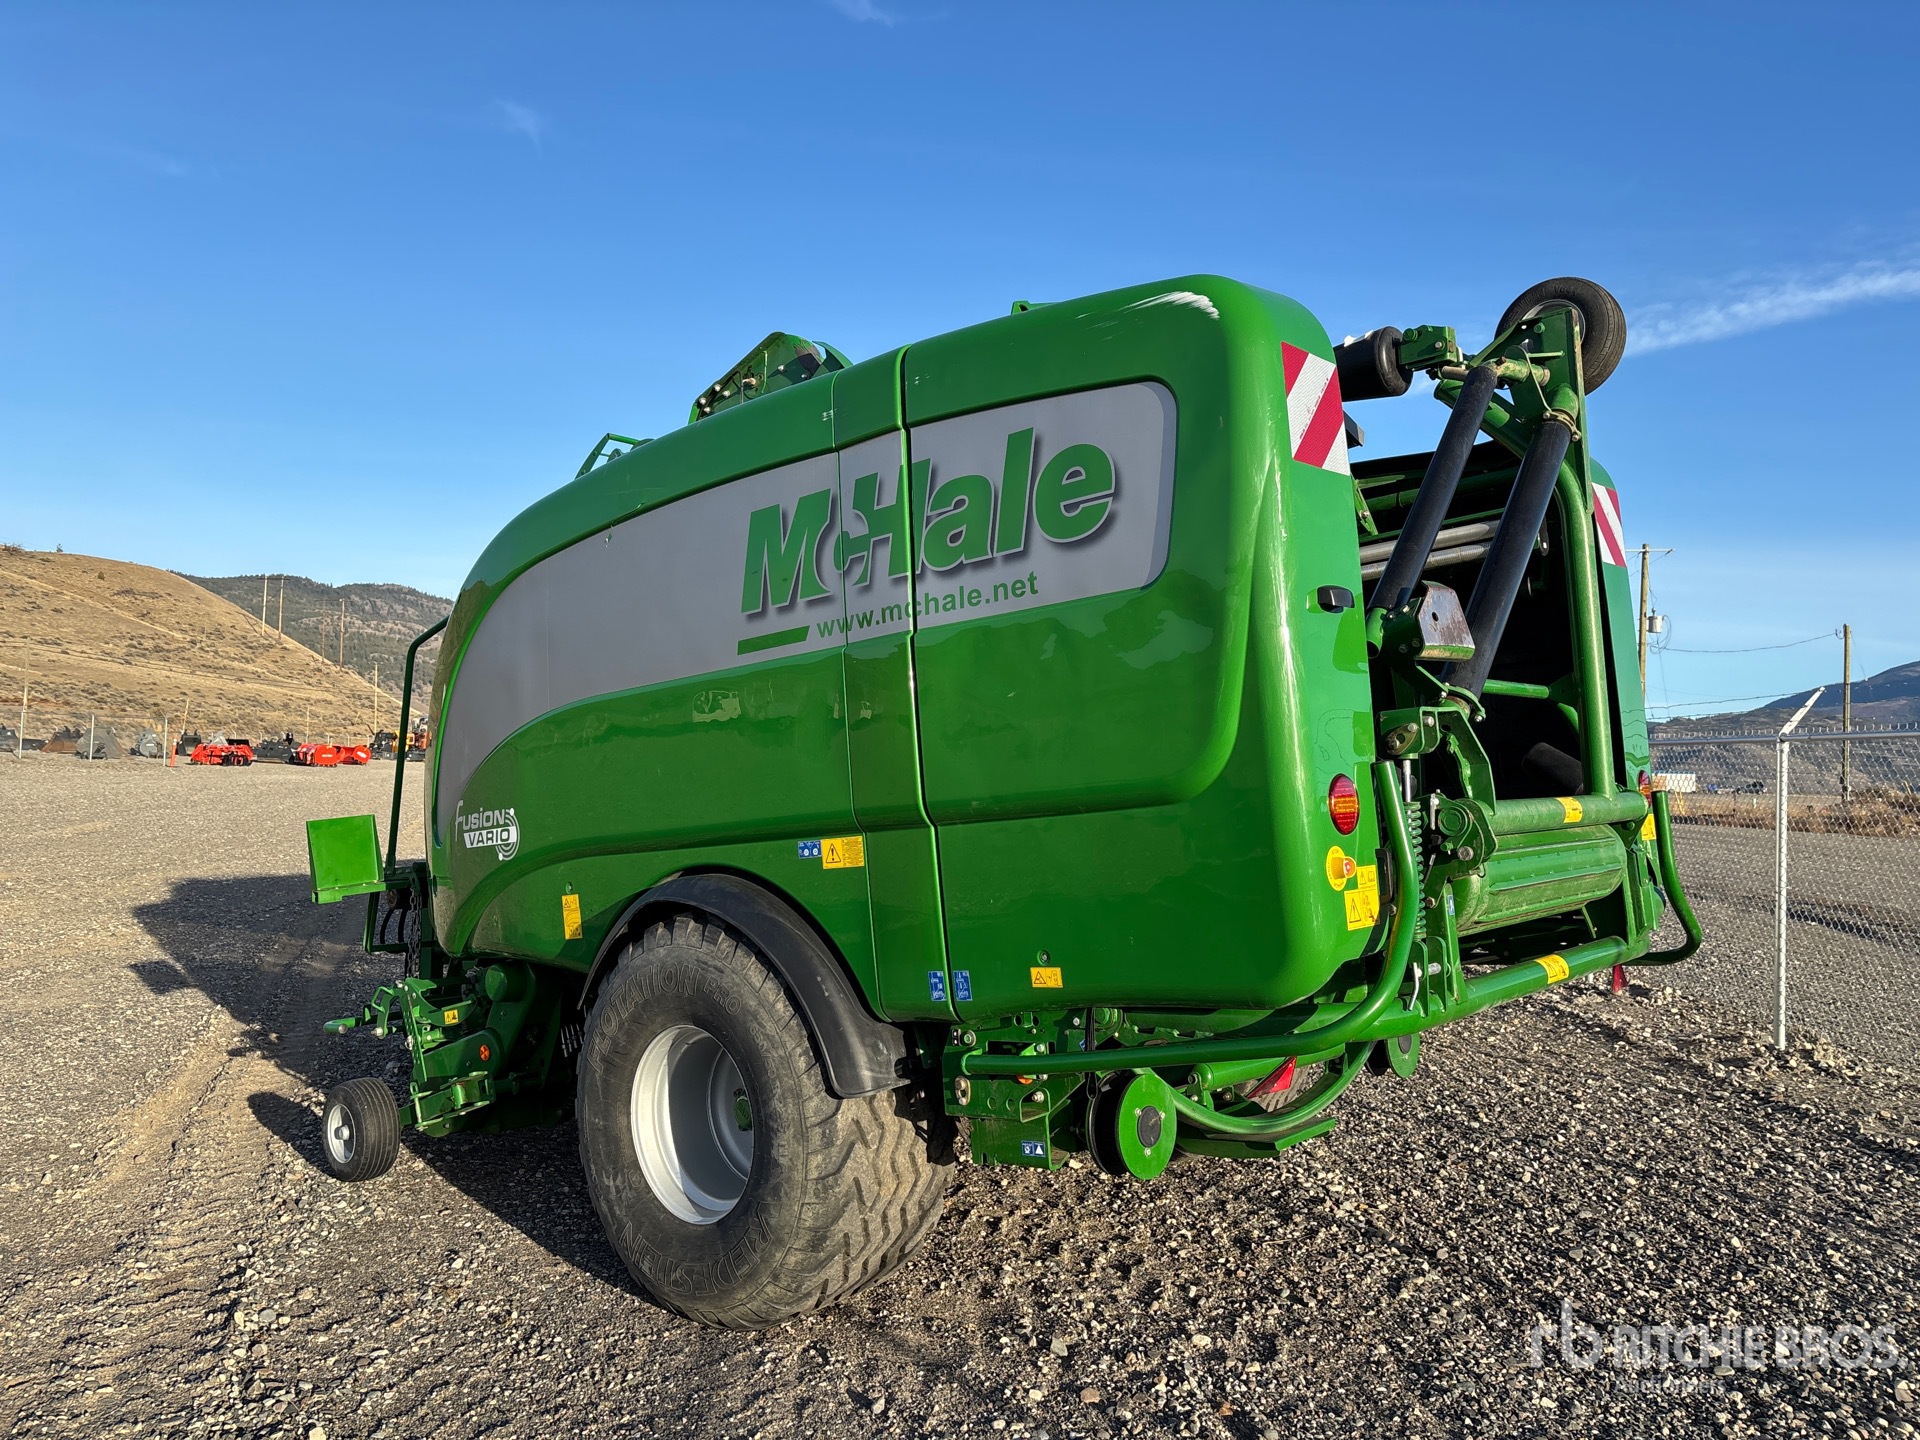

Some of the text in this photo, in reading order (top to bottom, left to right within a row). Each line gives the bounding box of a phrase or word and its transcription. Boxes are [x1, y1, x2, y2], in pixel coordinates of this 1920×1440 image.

[741, 426, 1116, 614] McHale
[816, 571, 1039, 639] www.mchale.net
[468, 828, 511, 846] VARIO
[587, 962, 742, 1076] FLOTATION PRO
